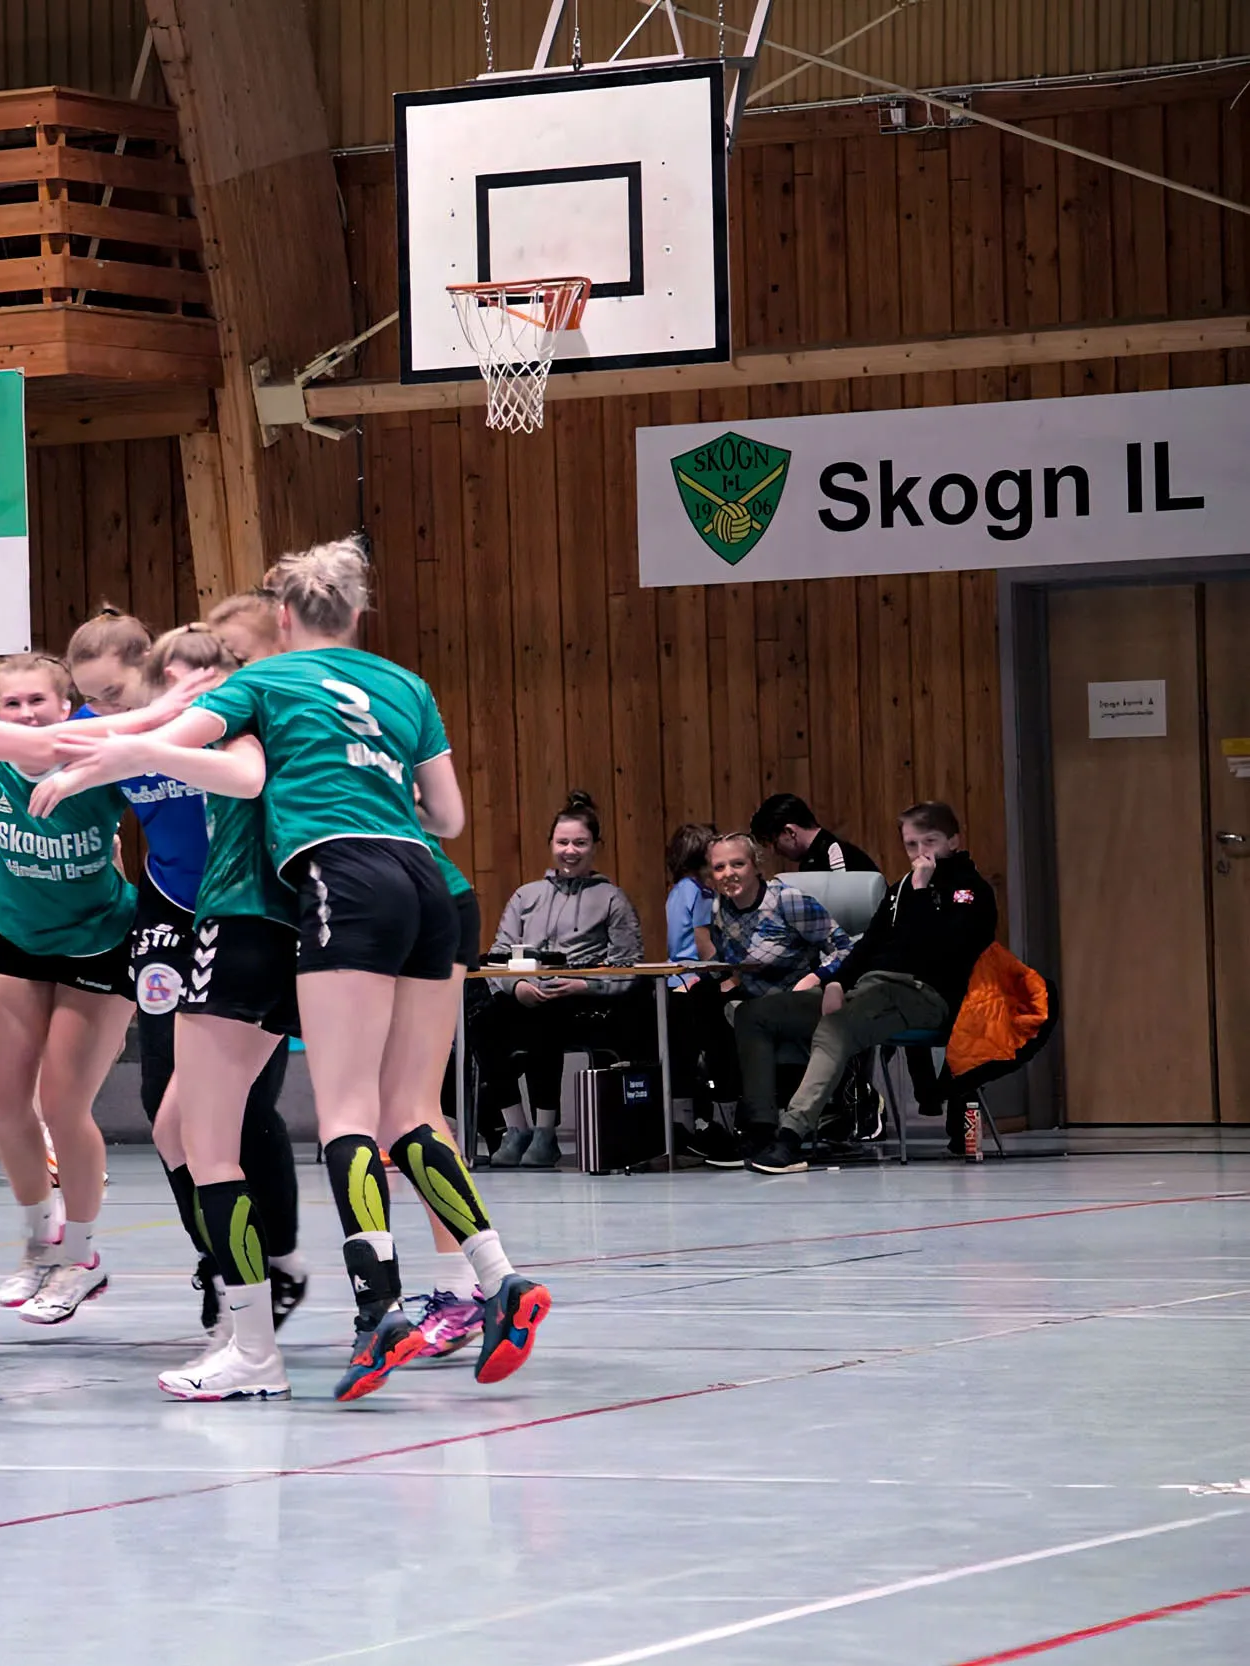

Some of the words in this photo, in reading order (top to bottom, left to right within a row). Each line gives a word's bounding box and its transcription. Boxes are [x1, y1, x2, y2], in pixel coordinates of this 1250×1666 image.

[693, 438, 769, 472] SKOGN
[752, 499, 773, 517] 06
[817, 458, 1090, 542] Skogn
[1126, 441, 1206, 515] IL
[693, 502, 713, 520] 19
[321, 678, 383, 737] 3
